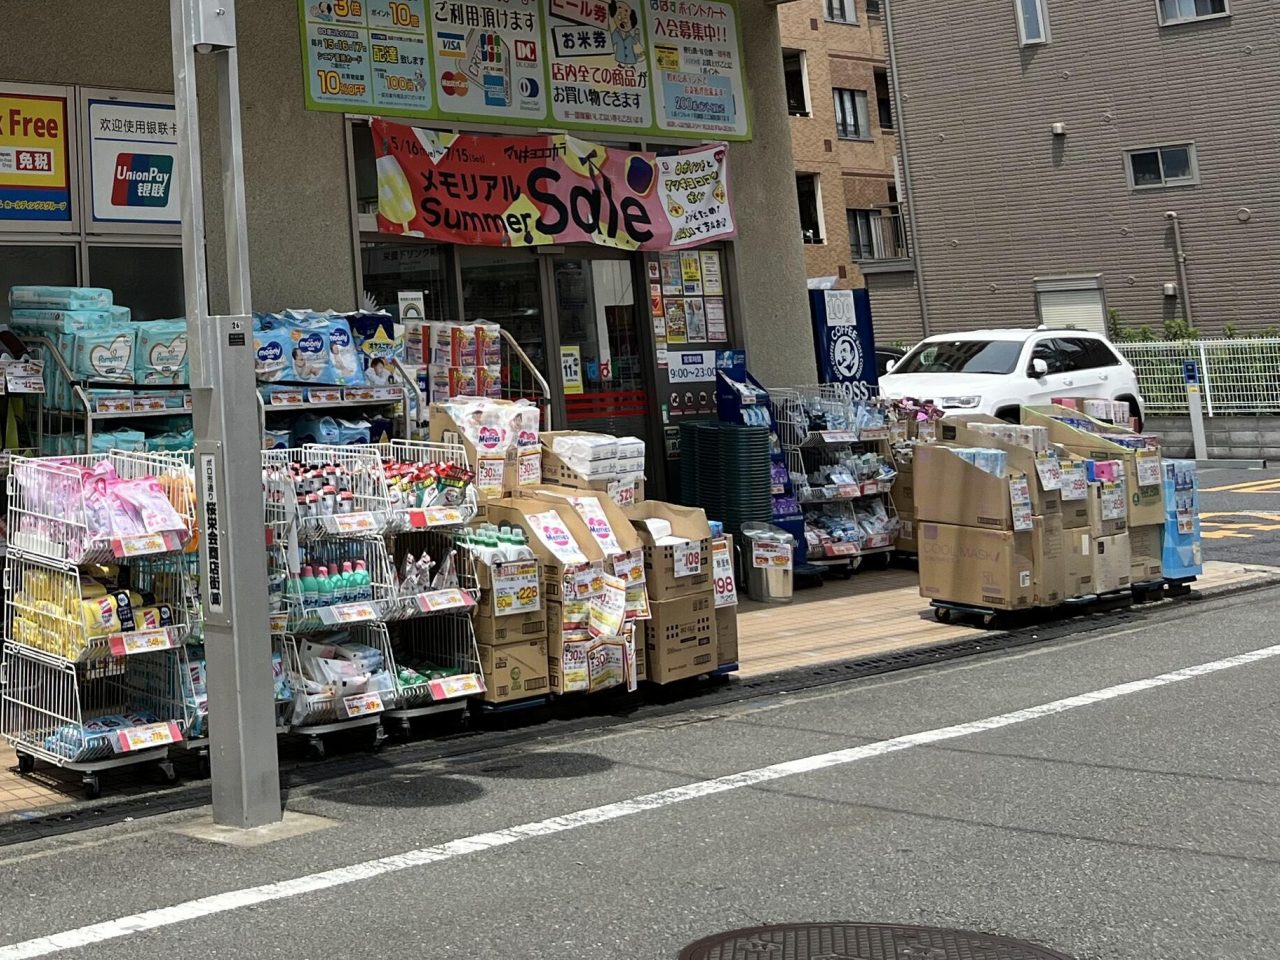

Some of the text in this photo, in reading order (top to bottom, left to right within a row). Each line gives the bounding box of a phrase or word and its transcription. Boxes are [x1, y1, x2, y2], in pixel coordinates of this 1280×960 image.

[434, 0, 536, 33] ご利用頂けます
[442, 39, 462, 52] VISA
[561, 30, 607, 50] お米券
[372, 44, 399, 65] 配達
[552, 63, 648, 89] 店内全ての商品が
[553, 86, 642, 109] お買い物できます
[9, 108, 59, 139] Free
[18, 152, 50, 171] 免税
[116, 165, 170, 187] UnionPay
[421, 170, 521, 200] メモリアル
[136, 183, 165, 198] 银联
[423, 167, 654, 242] Summer Sale
[831, 325, 859, 341] COFFEE
[258, 347, 281, 359] moony
[299, 339, 323, 351] moony
[834, 381, 870, 401] BOSS
[479, 434, 501, 444] Merries
[520, 586, 538, 600] 228
